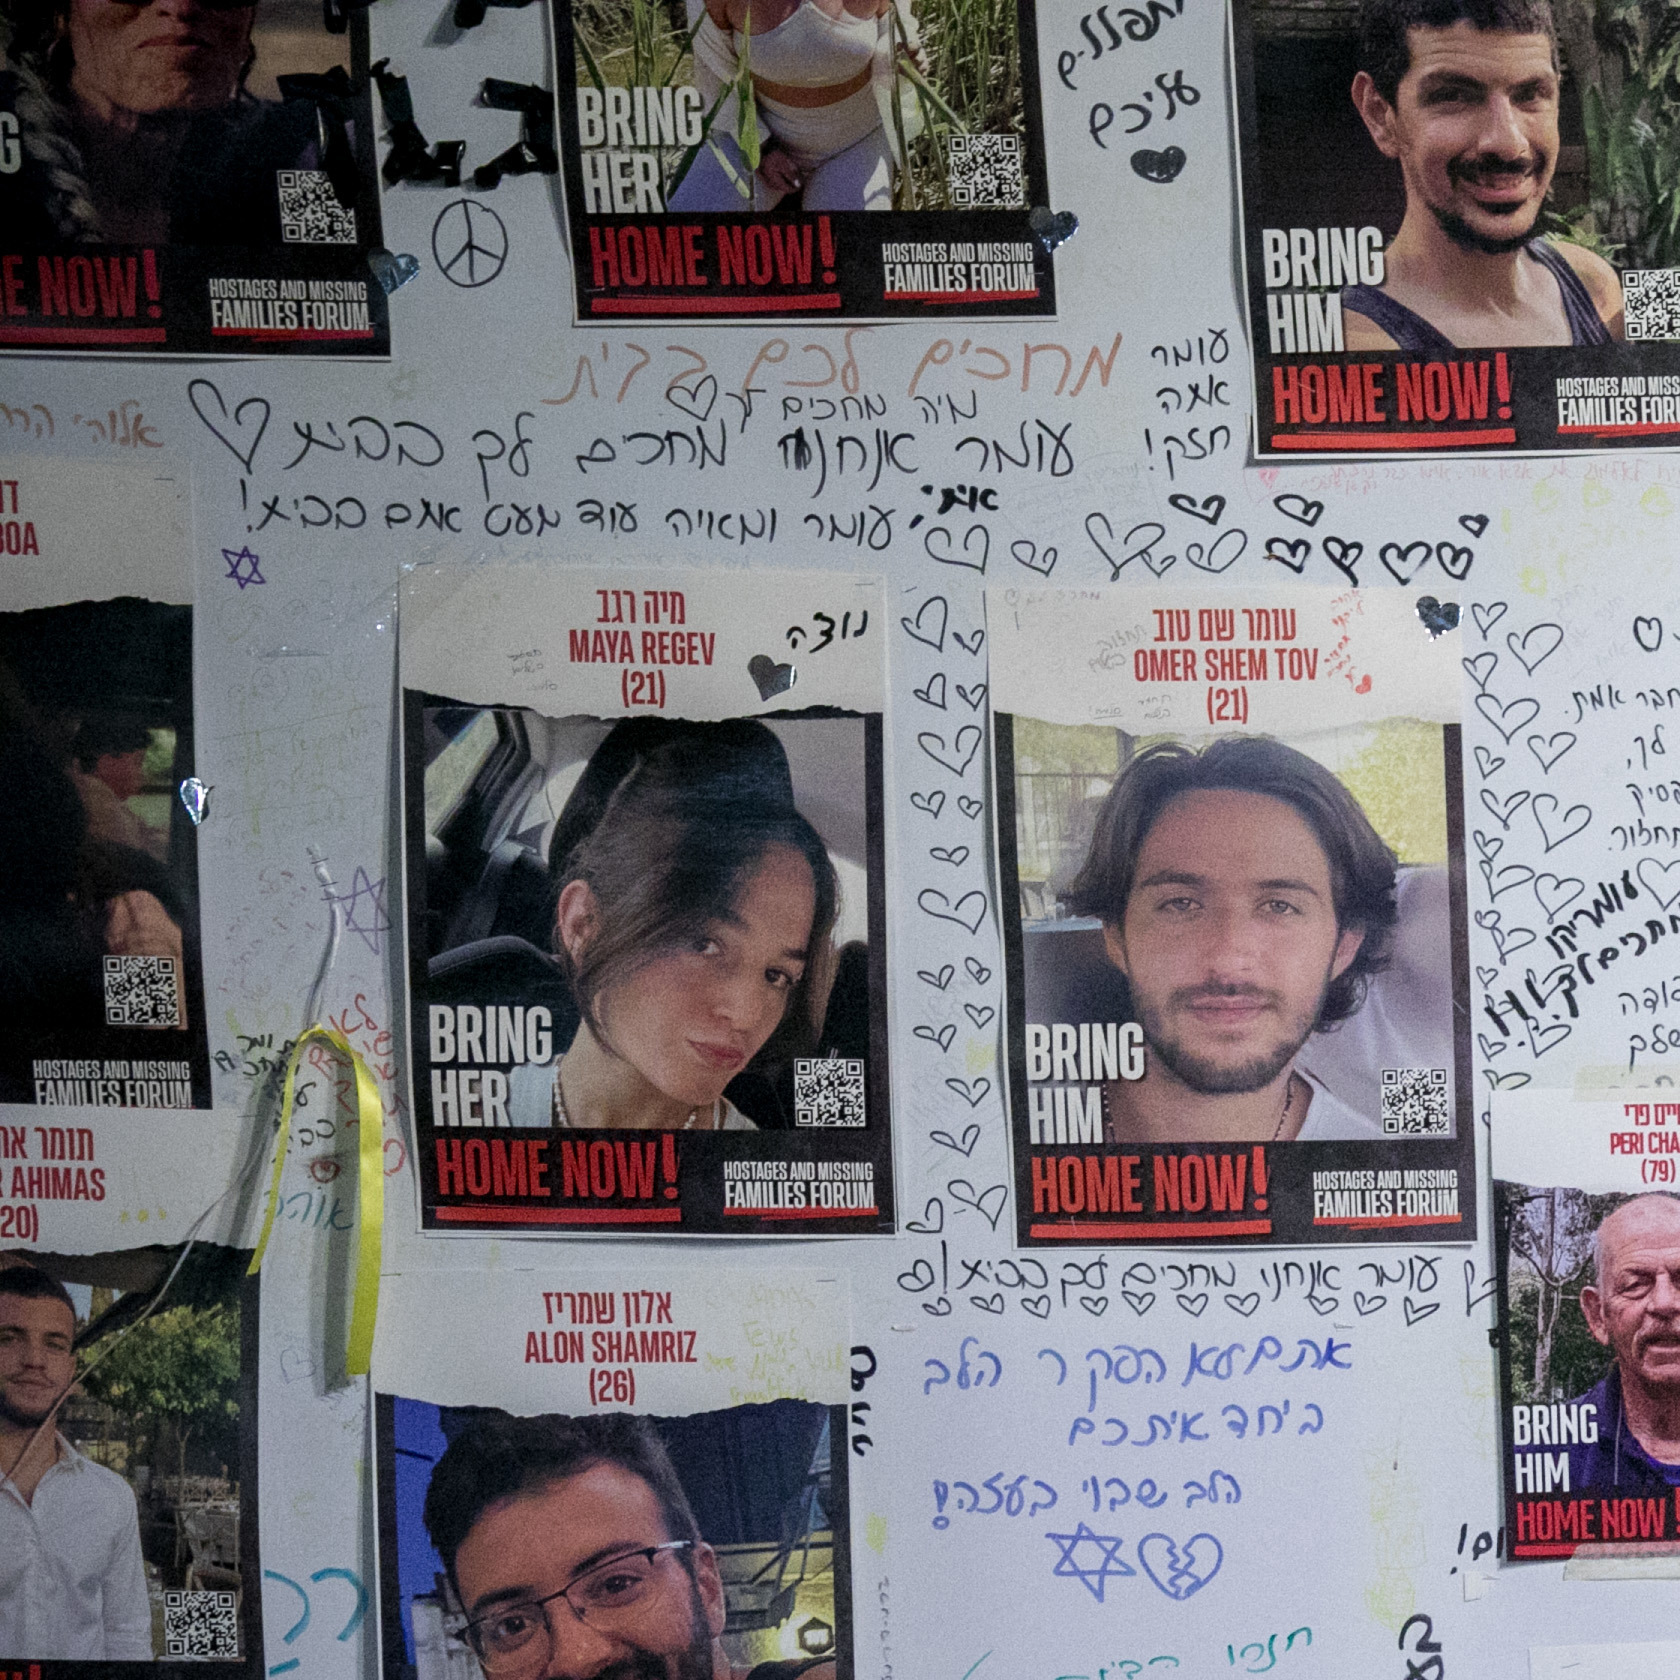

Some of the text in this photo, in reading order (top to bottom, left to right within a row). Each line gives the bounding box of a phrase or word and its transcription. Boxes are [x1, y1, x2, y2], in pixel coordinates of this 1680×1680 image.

[1262, 226, 1385, 289] BRING
[1266, 292, 1345, 354] HIM
[1272, 351, 1512, 424] HOME NOW!
[1556, 376, 1620, 398] HOSTAGES
[1620, 376, 1647, 396] AND
[1557, 395, 1638, 426] FAMILIES
[568, 628, 716, 666] MAYA REGEV
[1133, 647, 1319, 682] OMER SHEM TOV
[621, 668, 666, 709] (21)
[1206, 686, 1249, 724] (21)
[1609, 1131, 1645, 1155] PERI
[10, 1164, 106, 1202] AHIMAS
[1640, 1159, 1676, 1183] (79)
[524, 1329, 697, 1364] ALON SHAMRIZ
[588, 1367, 636, 1406] (26)
